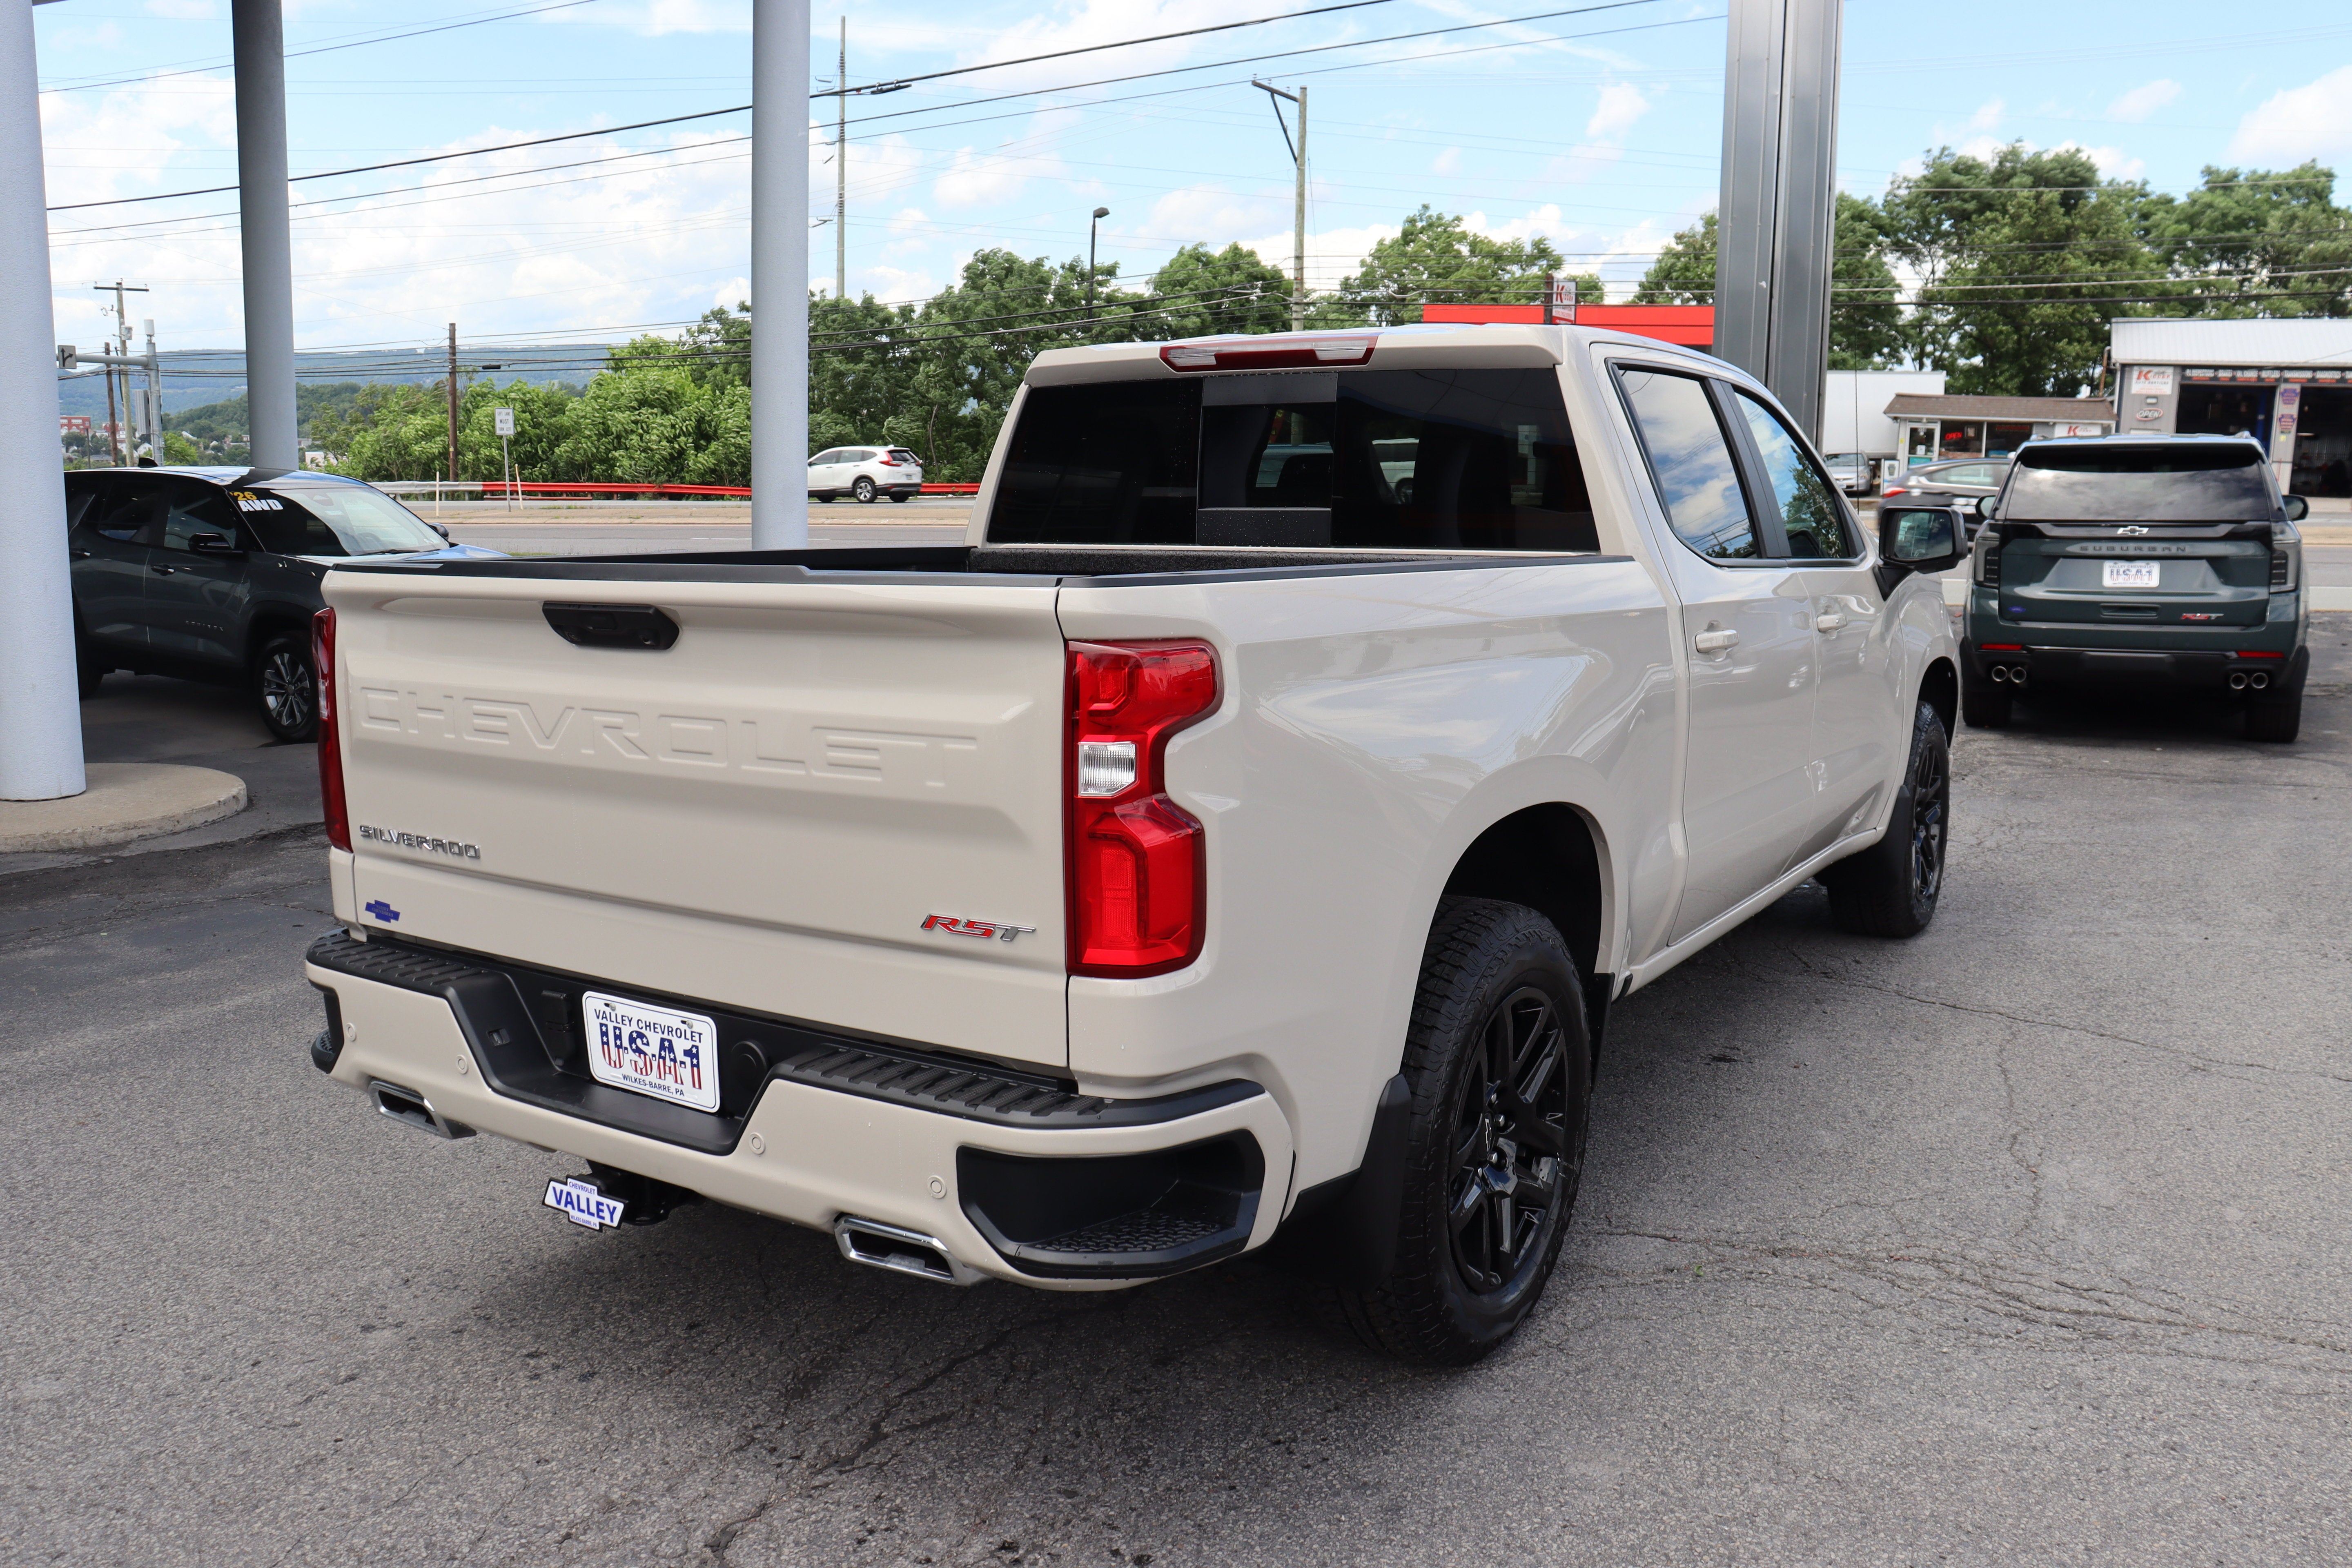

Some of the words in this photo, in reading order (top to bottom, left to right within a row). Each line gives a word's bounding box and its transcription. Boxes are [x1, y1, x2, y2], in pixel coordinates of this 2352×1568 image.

[2138, 410, 2160, 418] OPEN
[1945, 432, 1962, 441] OPEN
[230, 492, 257, 501] '26
[238, 499, 284, 512] AWD
[359, 686, 977, 787] CHEVROLET
[359, 824, 481, 859] SILVERADO
[920, 913, 1036, 942] RST
[594, 1009, 633, 1027] VALLEY
[637, 1019, 703, 1044] CHEVROLET
[622, 1074, 673, 1095] WILKES-BARRE,
[675, 1088, 684, 1096] PA
[569, 1181, 595, 1194] CHEVROLET
[552, 1186, 617, 1224] VALLEY
